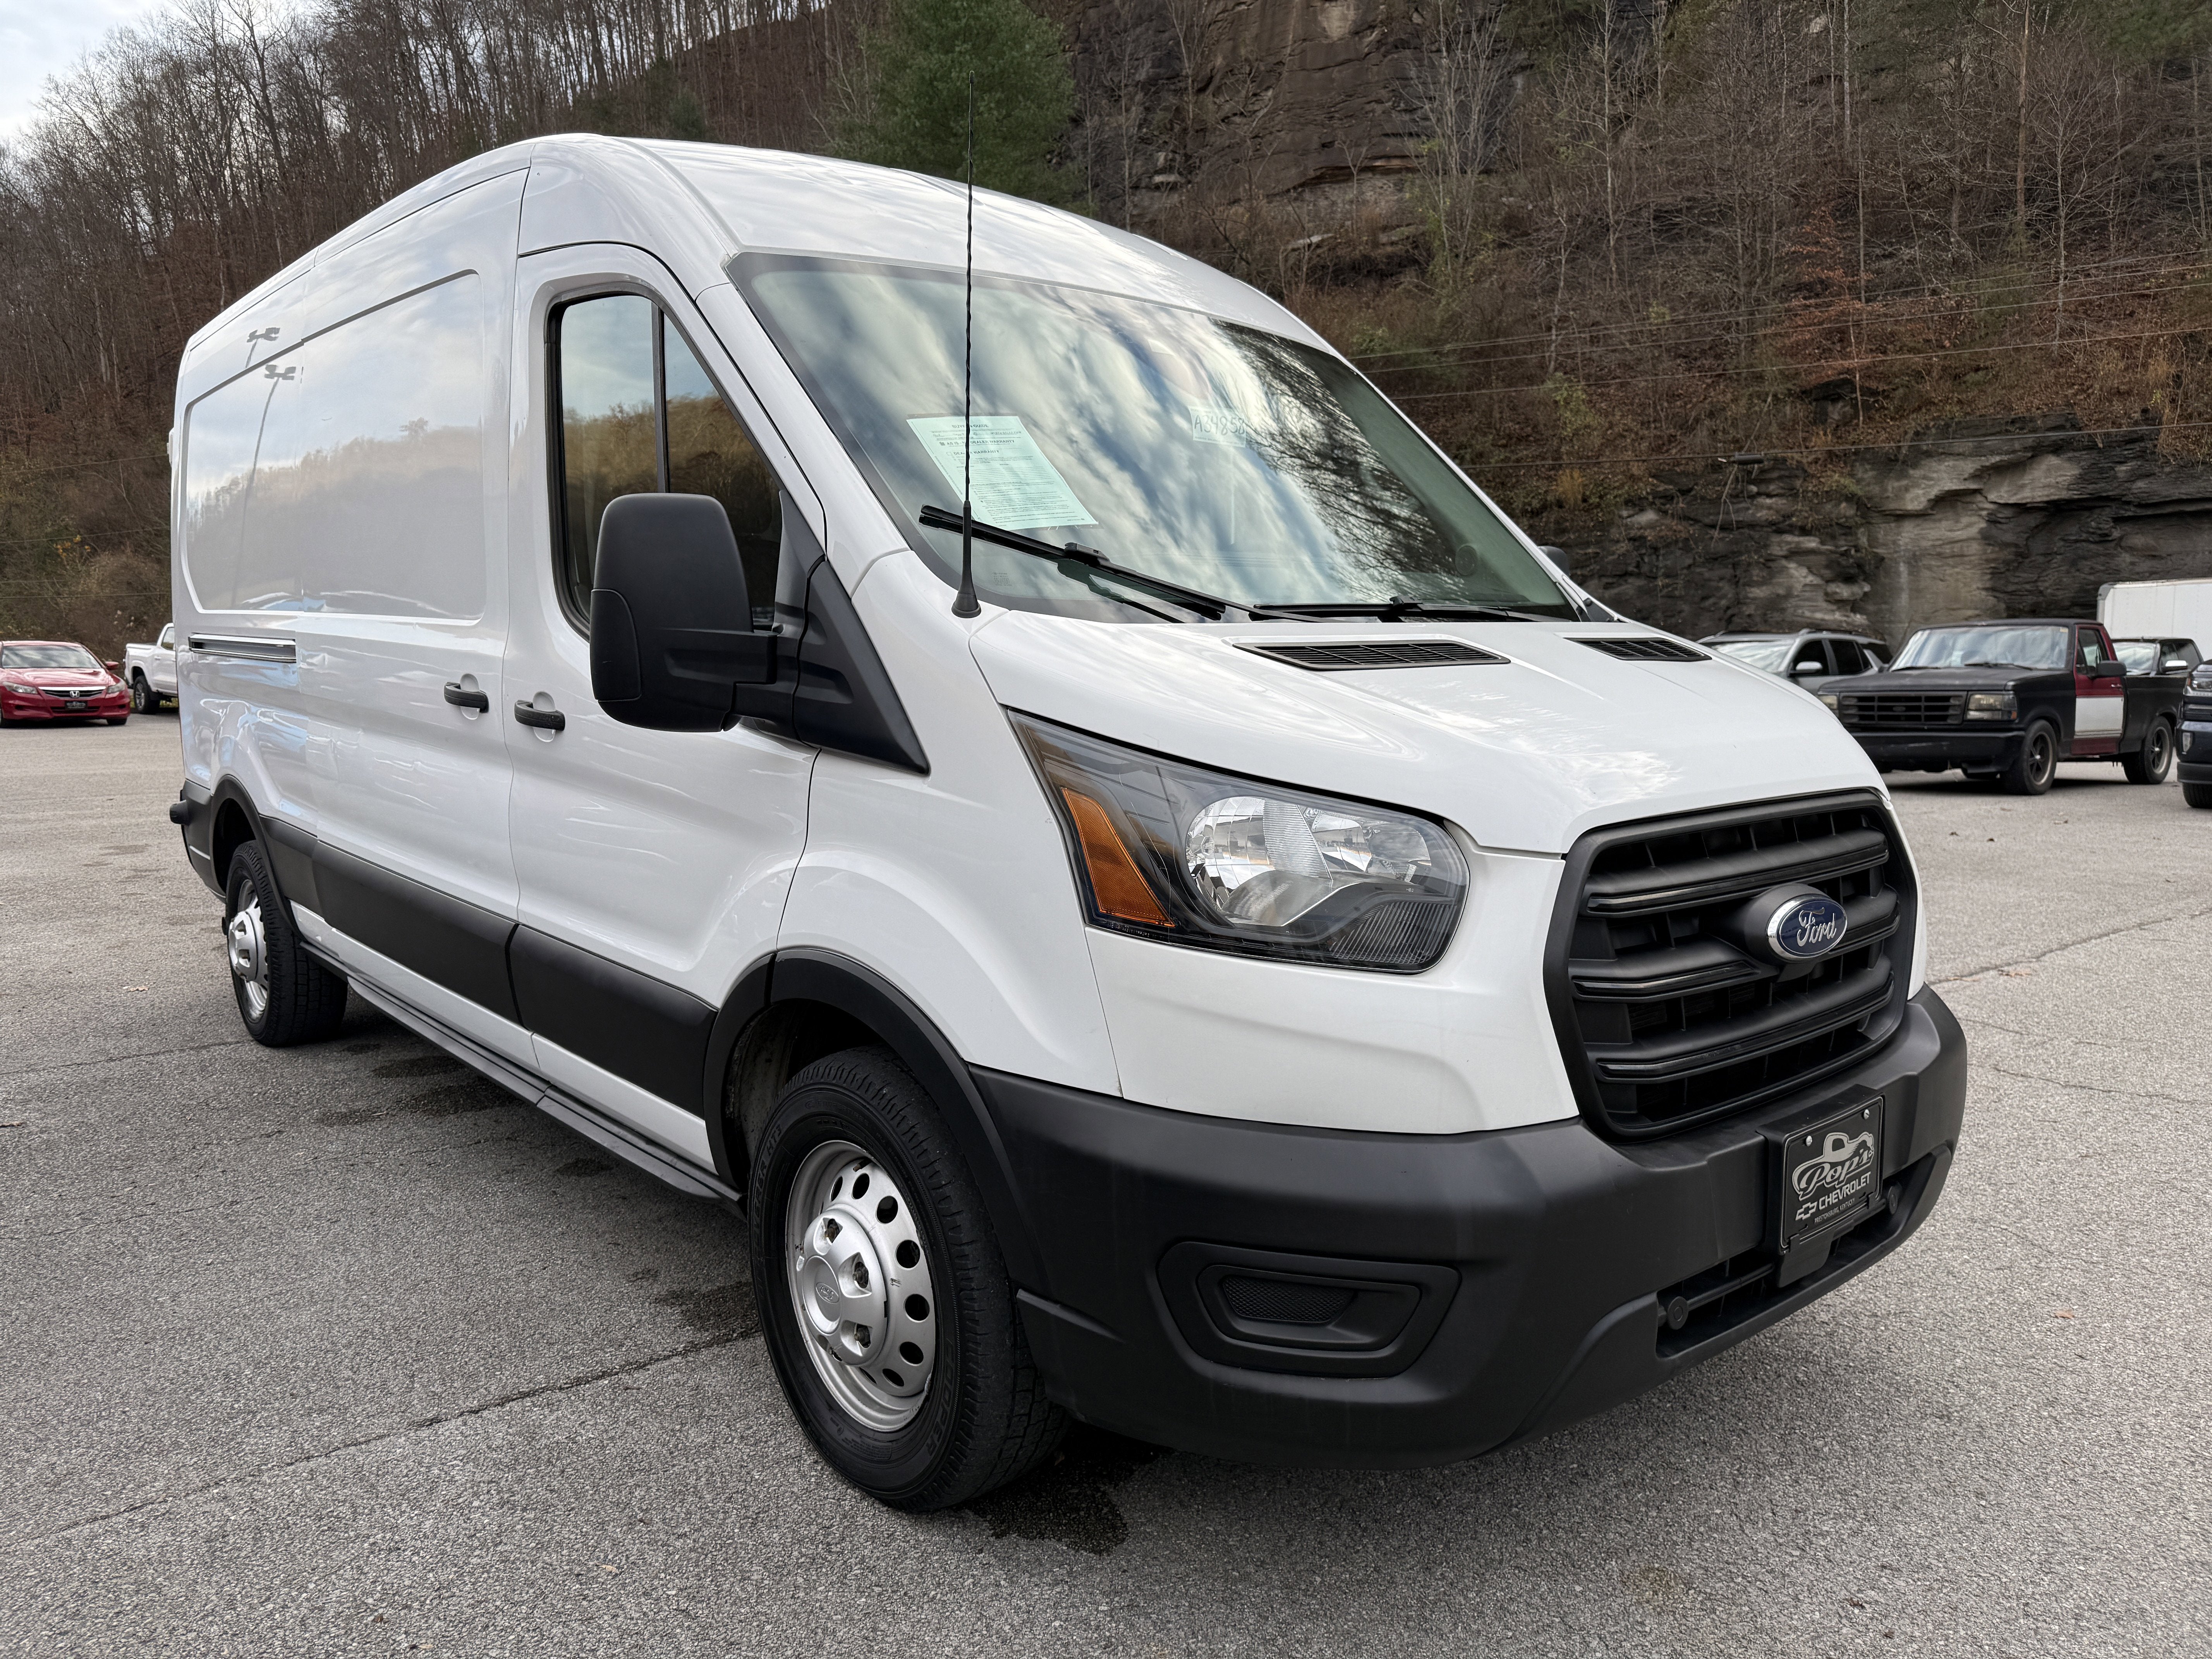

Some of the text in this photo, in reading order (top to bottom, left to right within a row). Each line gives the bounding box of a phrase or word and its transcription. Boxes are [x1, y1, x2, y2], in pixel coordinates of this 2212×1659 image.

[1194, 414, 1245, 436] A34858
[1796, 907, 1837, 946] Ford
[1819, 1171, 1871, 1211] CHEVROLET
